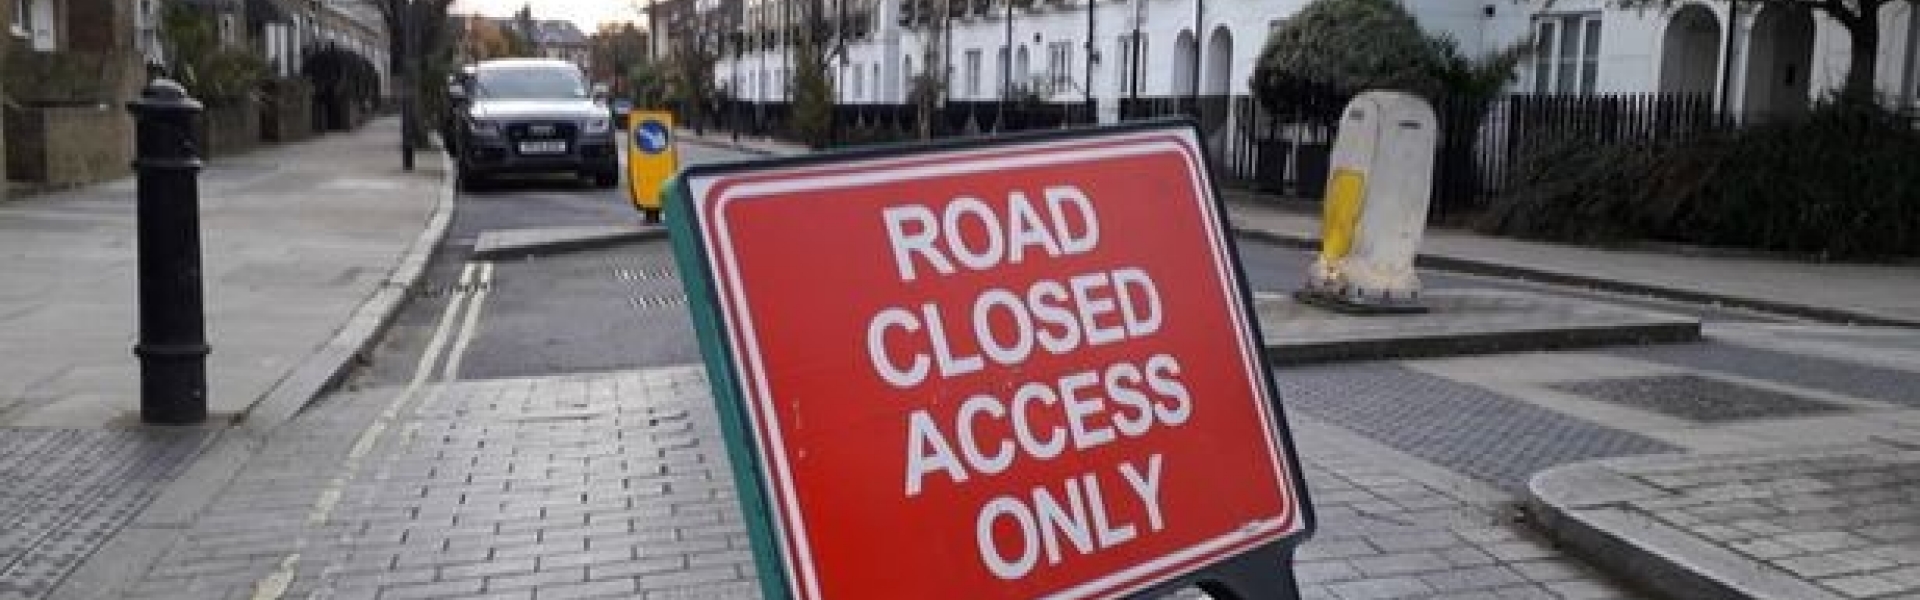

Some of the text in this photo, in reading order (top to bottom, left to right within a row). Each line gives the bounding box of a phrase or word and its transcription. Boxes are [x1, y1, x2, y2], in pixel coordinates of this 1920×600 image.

[883, 185, 1099, 281] ROAD
[868, 267, 1162, 387] CLOSED
[906, 354, 1191, 496] ACCESS
[977, 454, 1163, 579] ONLY
